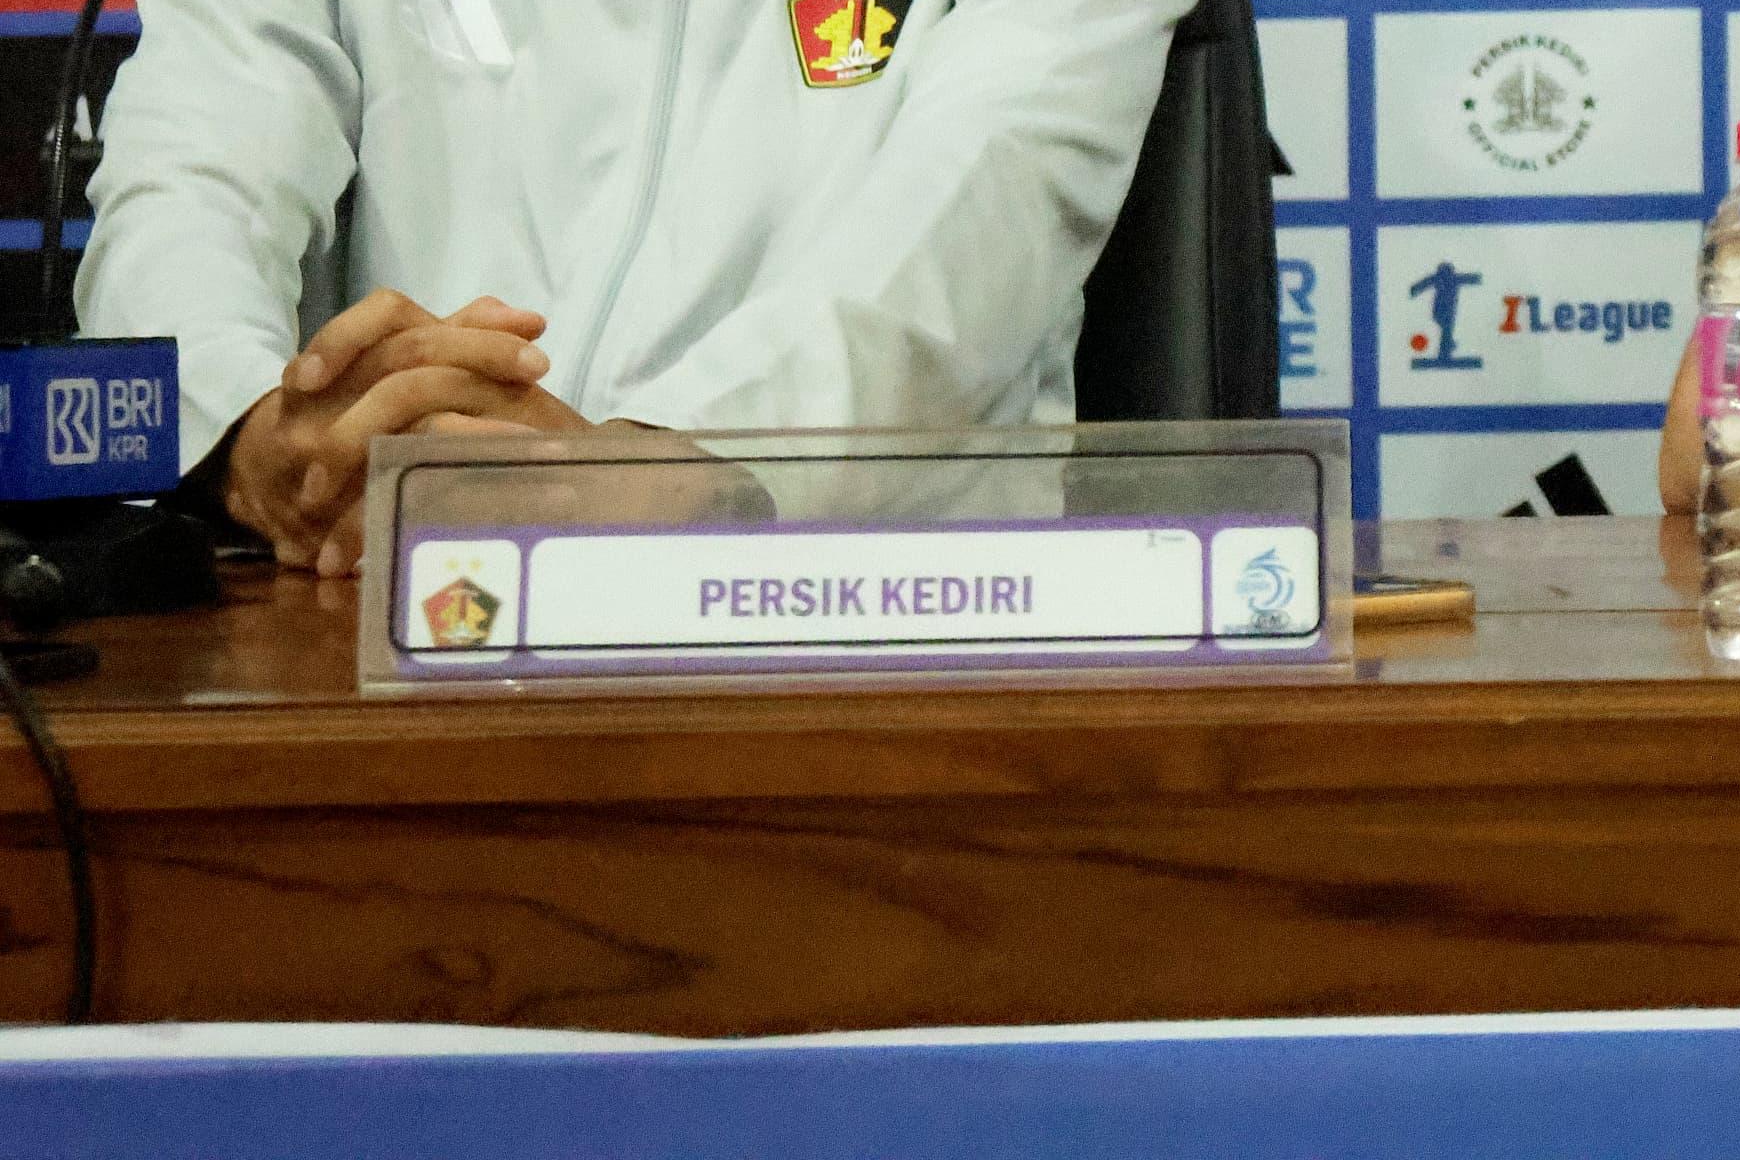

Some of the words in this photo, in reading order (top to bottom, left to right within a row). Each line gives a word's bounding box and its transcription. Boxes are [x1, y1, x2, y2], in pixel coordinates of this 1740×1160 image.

[107, 378, 162, 428] BRI
[109, 435, 148, 462] KPR
[699, 577, 866, 617] PERSIK
[881, 576, 1032, 616] KEDIRI
